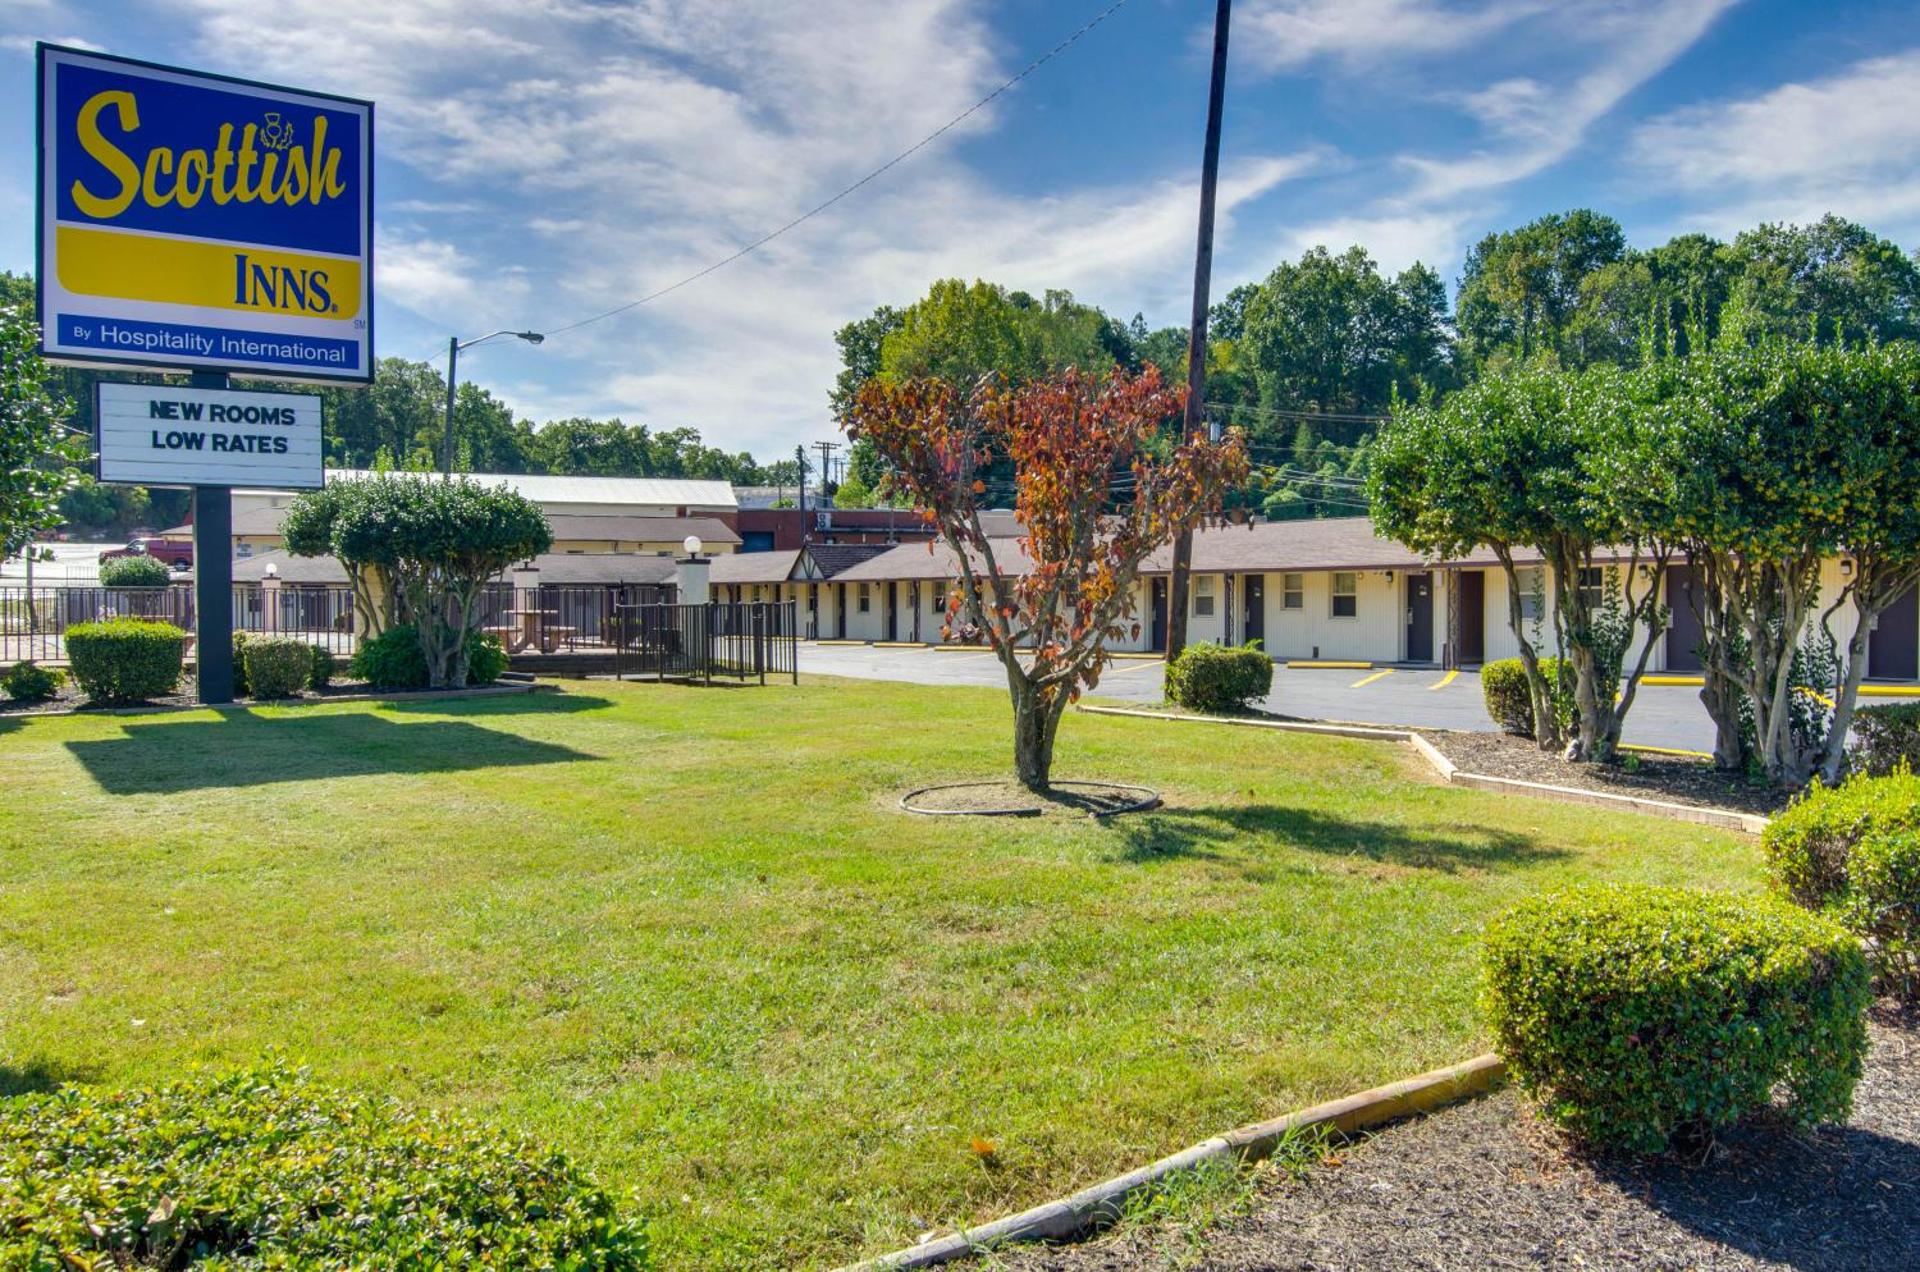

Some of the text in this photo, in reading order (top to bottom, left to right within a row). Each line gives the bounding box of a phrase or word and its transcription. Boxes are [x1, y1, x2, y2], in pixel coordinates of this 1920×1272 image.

[71, 89, 346, 219] Scottish
[73, 324, 346, 363] By Hospitality International
[149, 400, 296, 426] NEW ROOMS
[151, 429, 289, 454] LOW RATES
